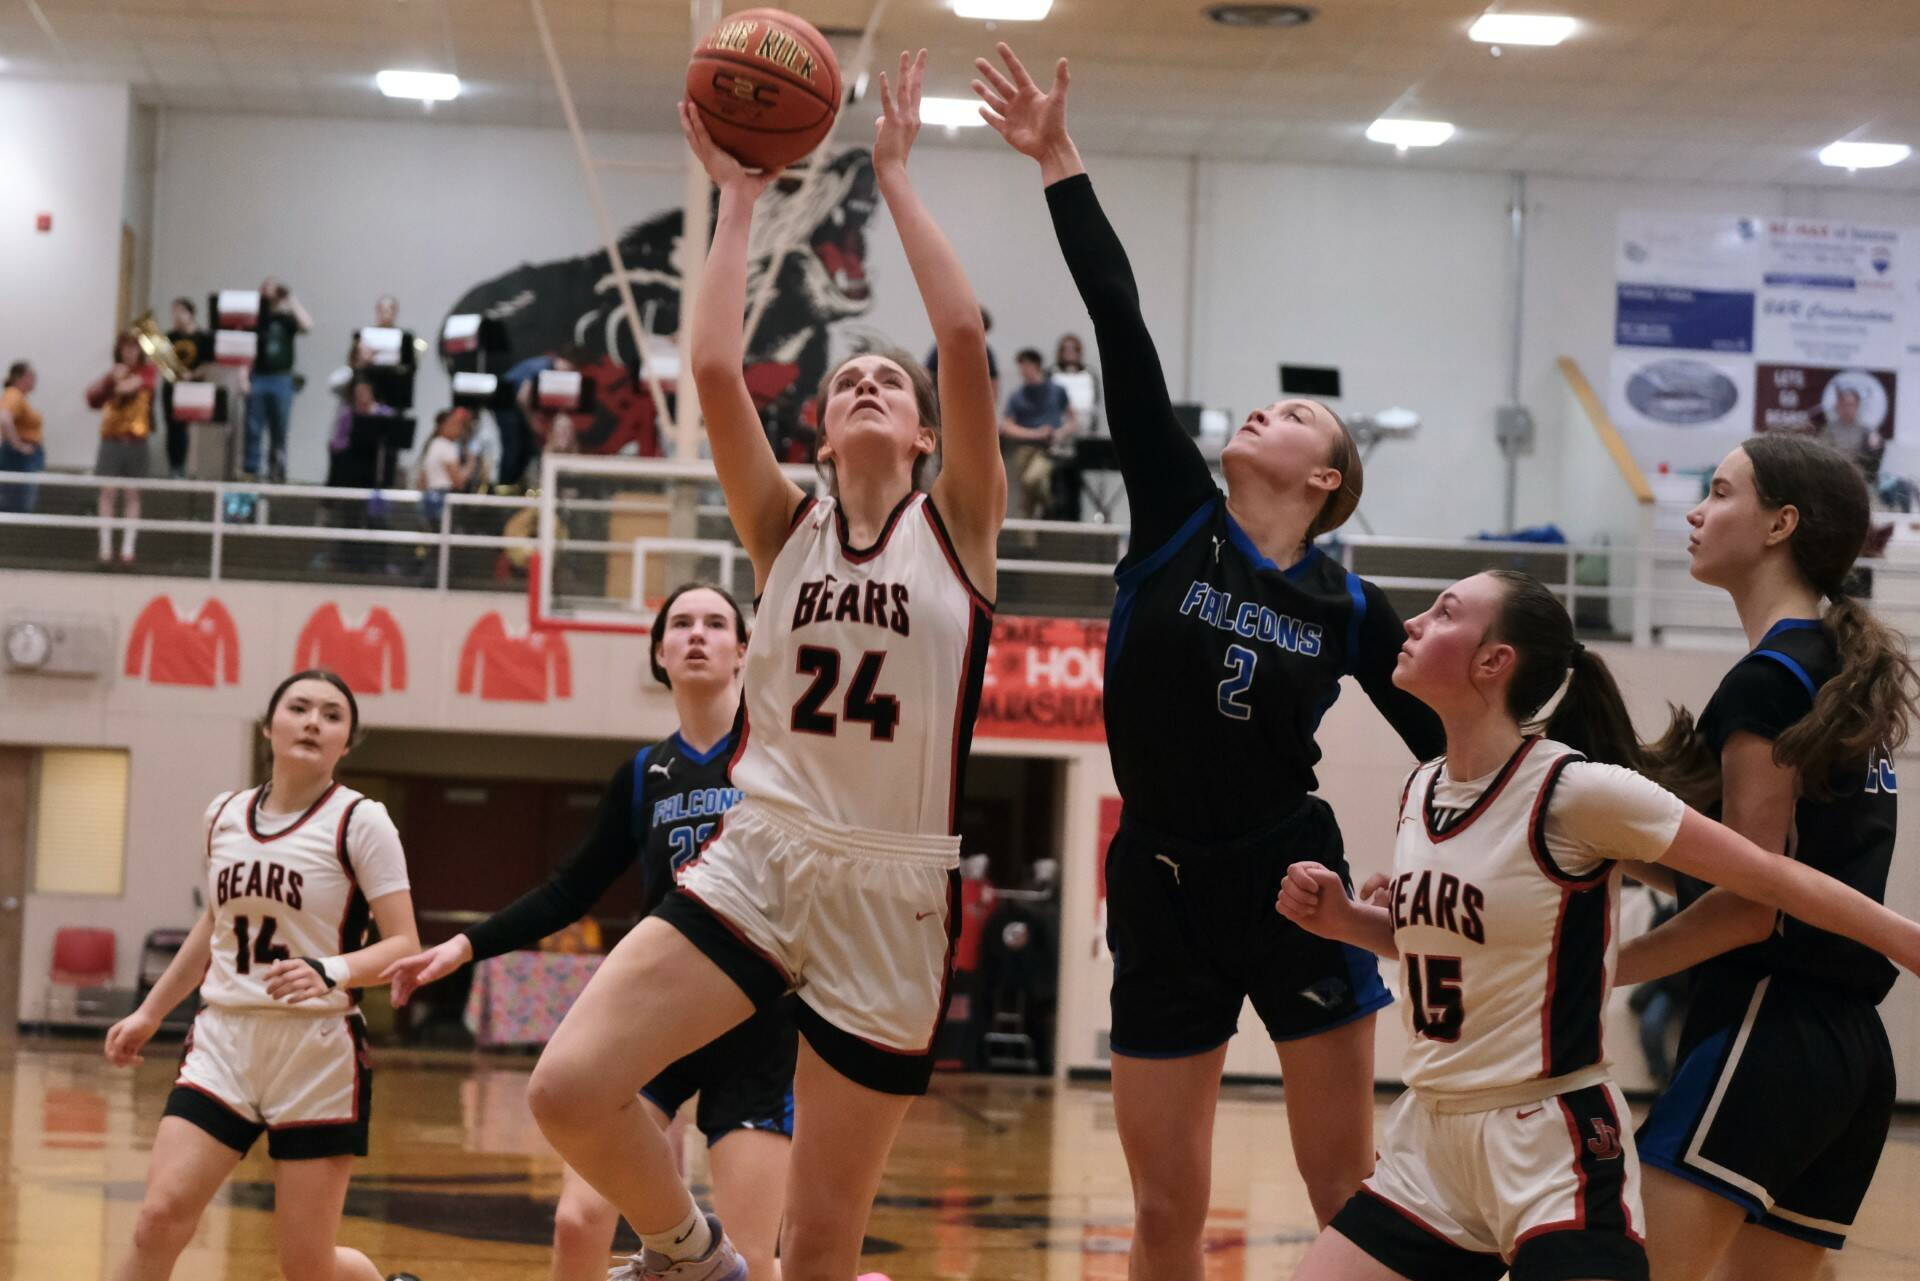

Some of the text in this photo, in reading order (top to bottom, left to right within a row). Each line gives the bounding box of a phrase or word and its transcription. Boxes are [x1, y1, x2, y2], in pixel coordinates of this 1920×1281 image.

[791, 574, 910, 637] BEARS
[1179, 580, 1323, 657] FALCONS
[790, 644, 901, 742] 24
[1217, 643, 1258, 720] 2
[217, 860, 304, 911] BEARS
[668, 822, 717, 882] 2
[233, 912, 291, 975] 14
[1405, 953, 1464, 1043] 15
